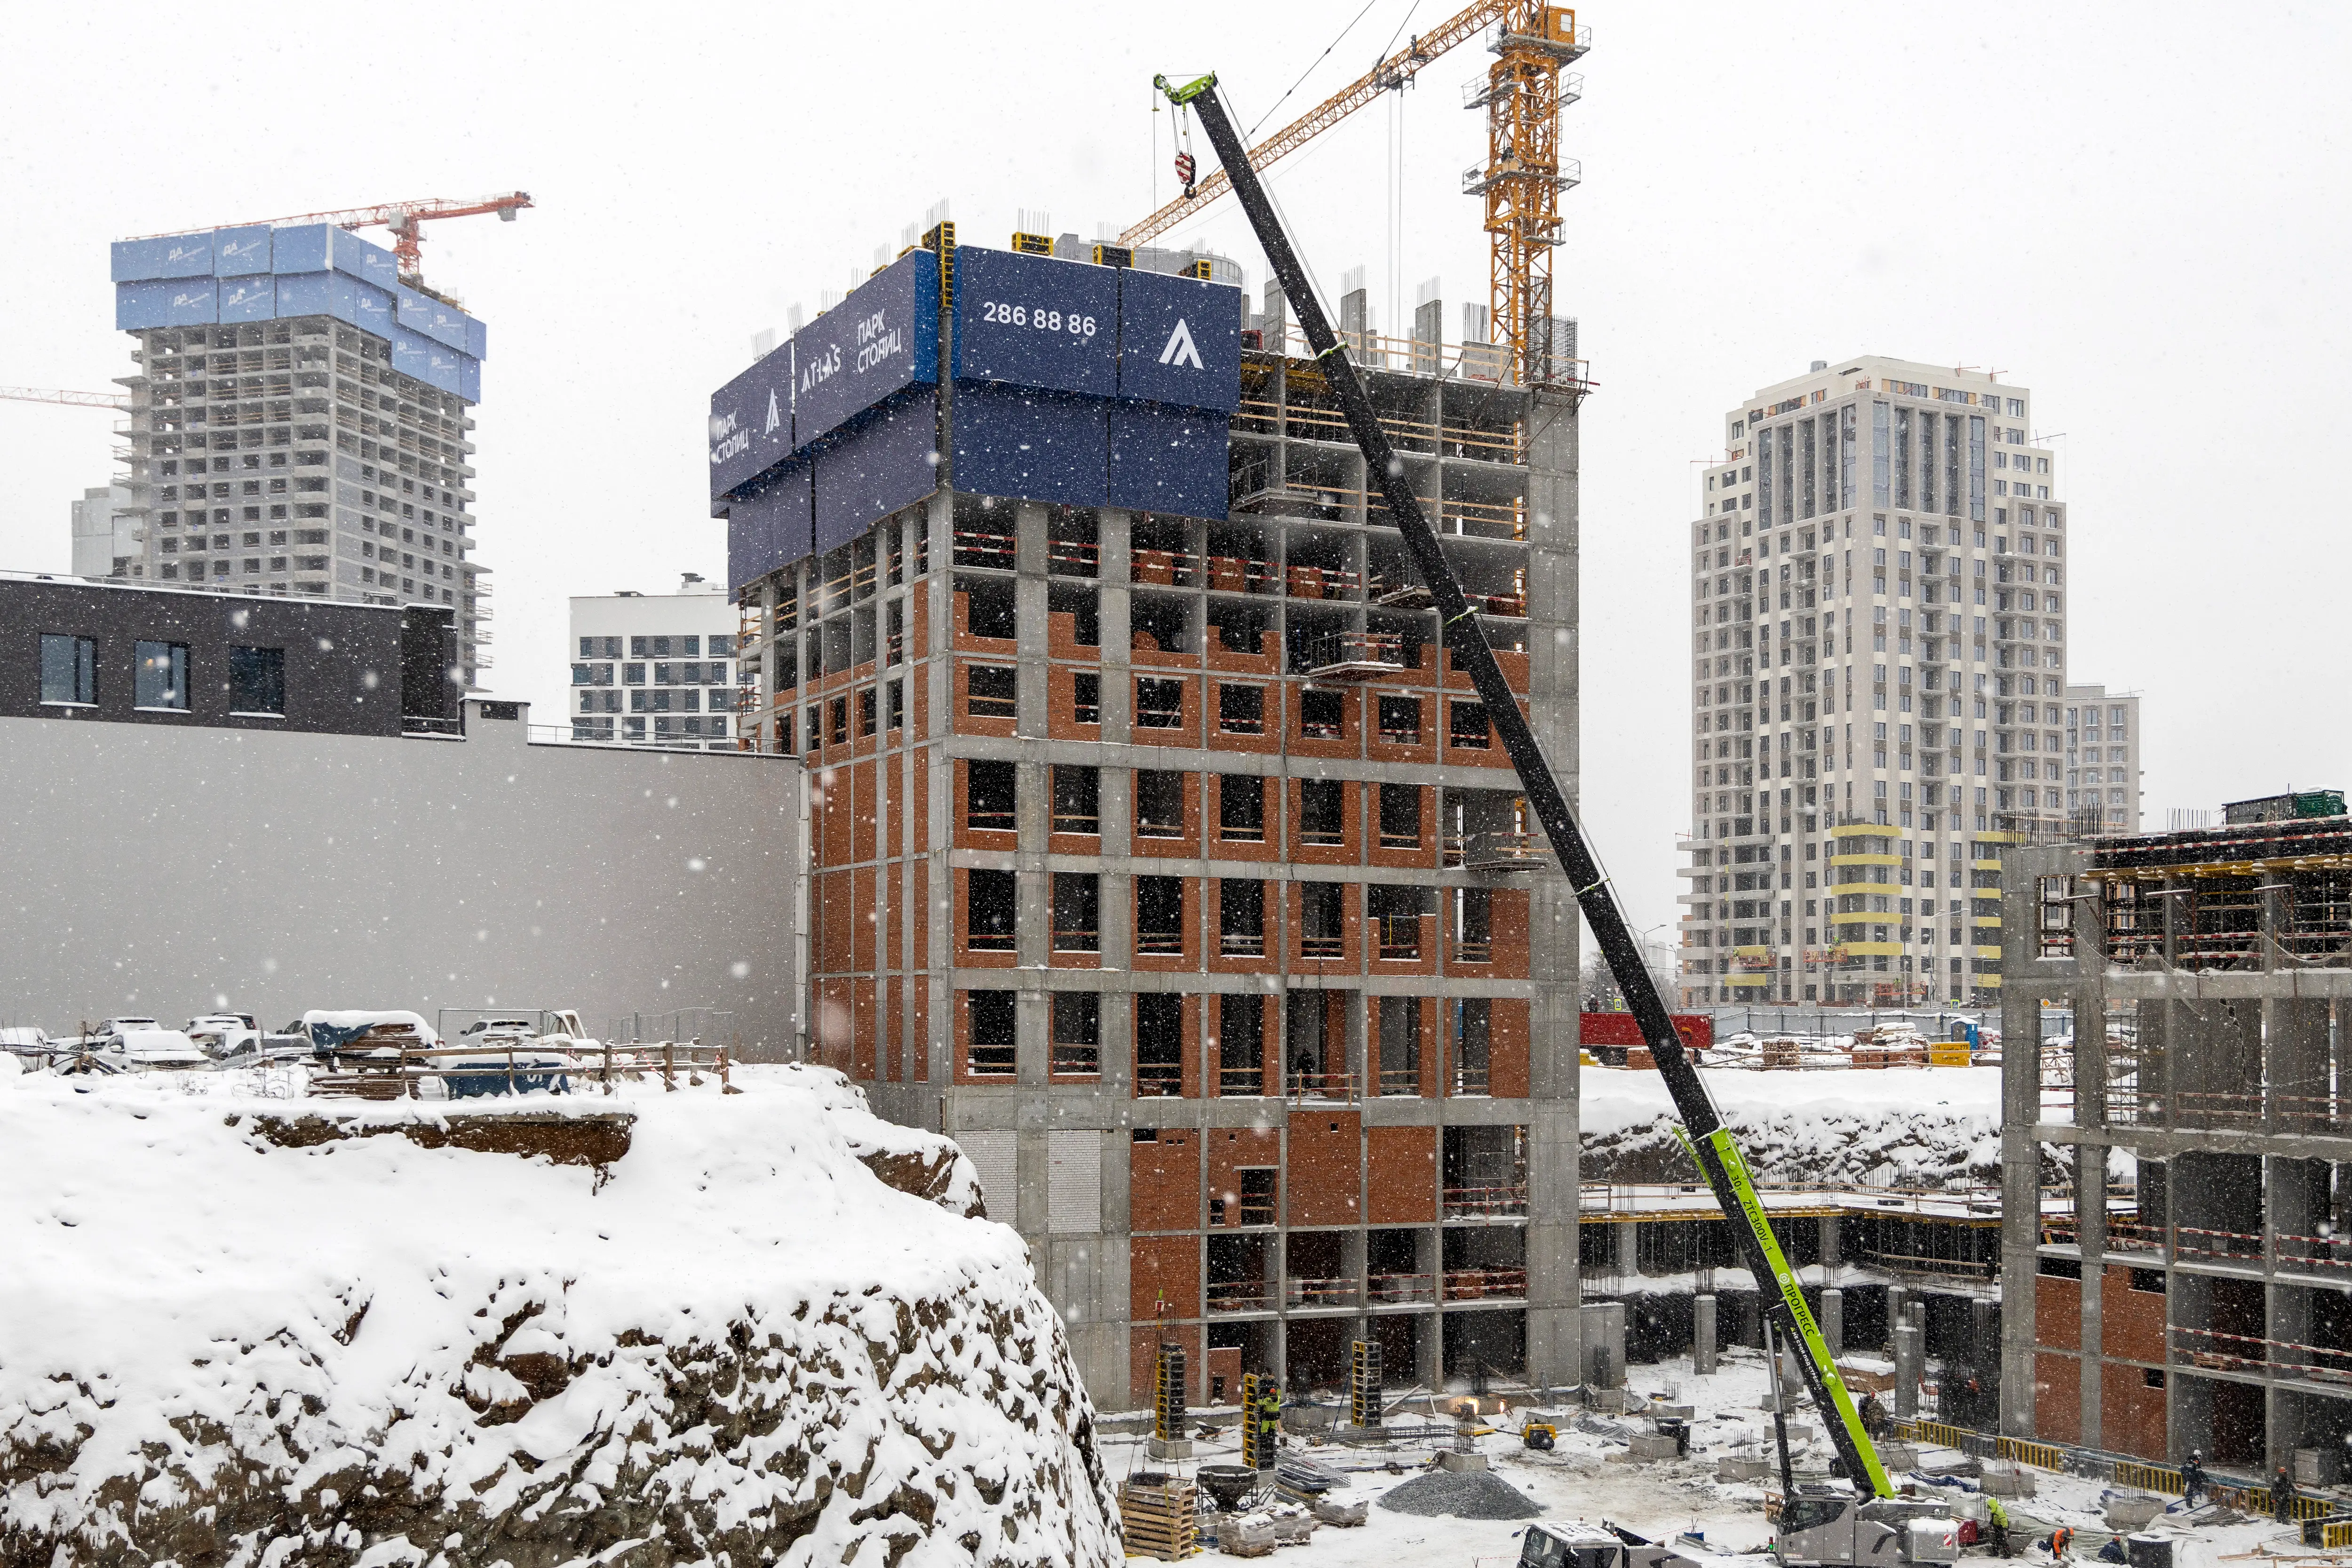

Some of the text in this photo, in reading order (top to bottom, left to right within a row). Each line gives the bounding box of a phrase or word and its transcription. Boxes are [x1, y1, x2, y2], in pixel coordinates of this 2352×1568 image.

[858, 308, 885, 346] ПАРК
[983, 301, 1096, 336] 286 88 86
[857, 327, 901, 373] СТОЛИЦ
[801, 347, 841, 393] ATLAS
[716, 410, 737, 440] ПАРК
[716, 428, 749, 464] СТОЛИЦ
[1743, 1200, 1773, 1251] ZTC300V-1
[1784, 1283, 1815, 1337] ПРОГРЕСС
[1796, 1340, 1805, 1354] СТОЙ
